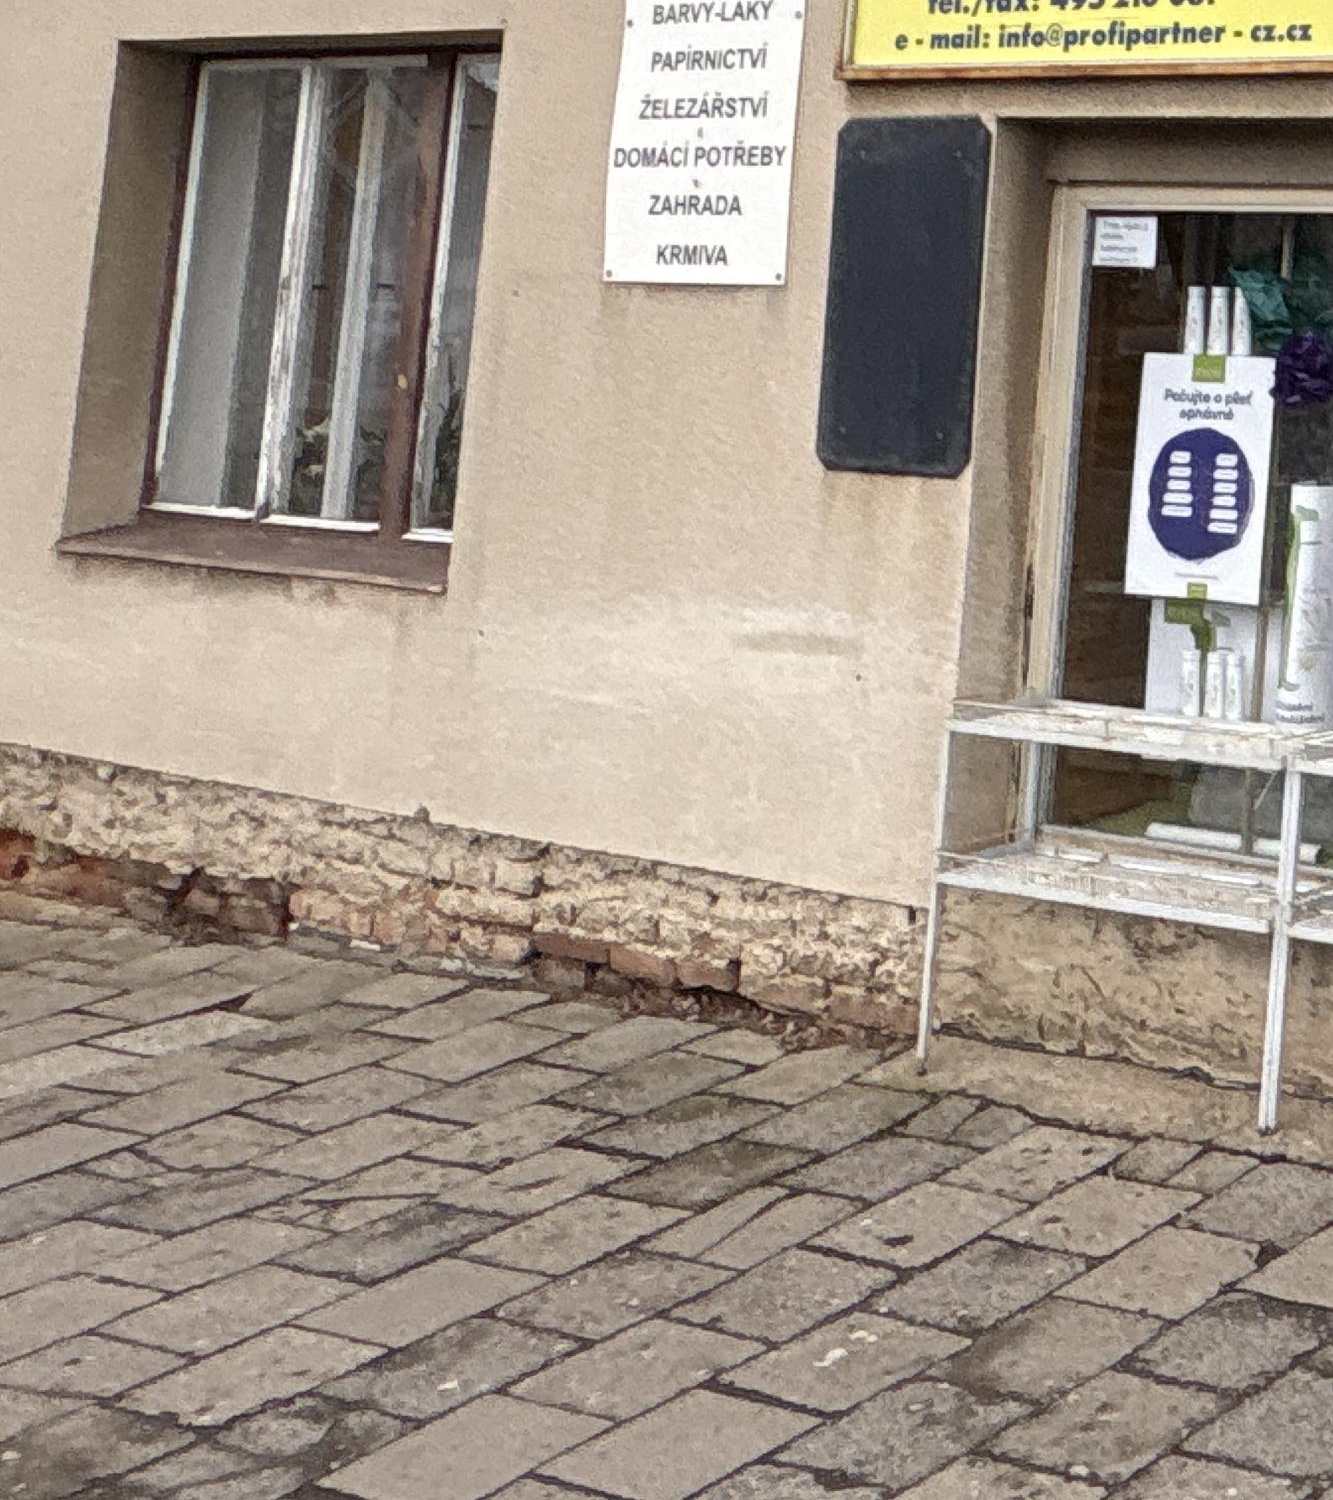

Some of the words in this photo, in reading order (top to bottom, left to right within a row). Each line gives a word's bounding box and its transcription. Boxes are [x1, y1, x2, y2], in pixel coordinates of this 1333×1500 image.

[930, 27, 991, 51] mail:
[998, 20, 1226, 52] info@profipartner
[1250, 21, 1313, 43] cz.cz
[651, 41, 769, 73] PAPÍRNICTVÍ
[638, 90, 770, 121] ŽELEZÁŘSTVÍ
[613, 140, 690, 169] DOMÁCÍ
[694, 140, 787, 168] POTŘEBY
[648, 194, 743, 217] ZAHRADA
[656, 243, 730, 267] KRMIVA
